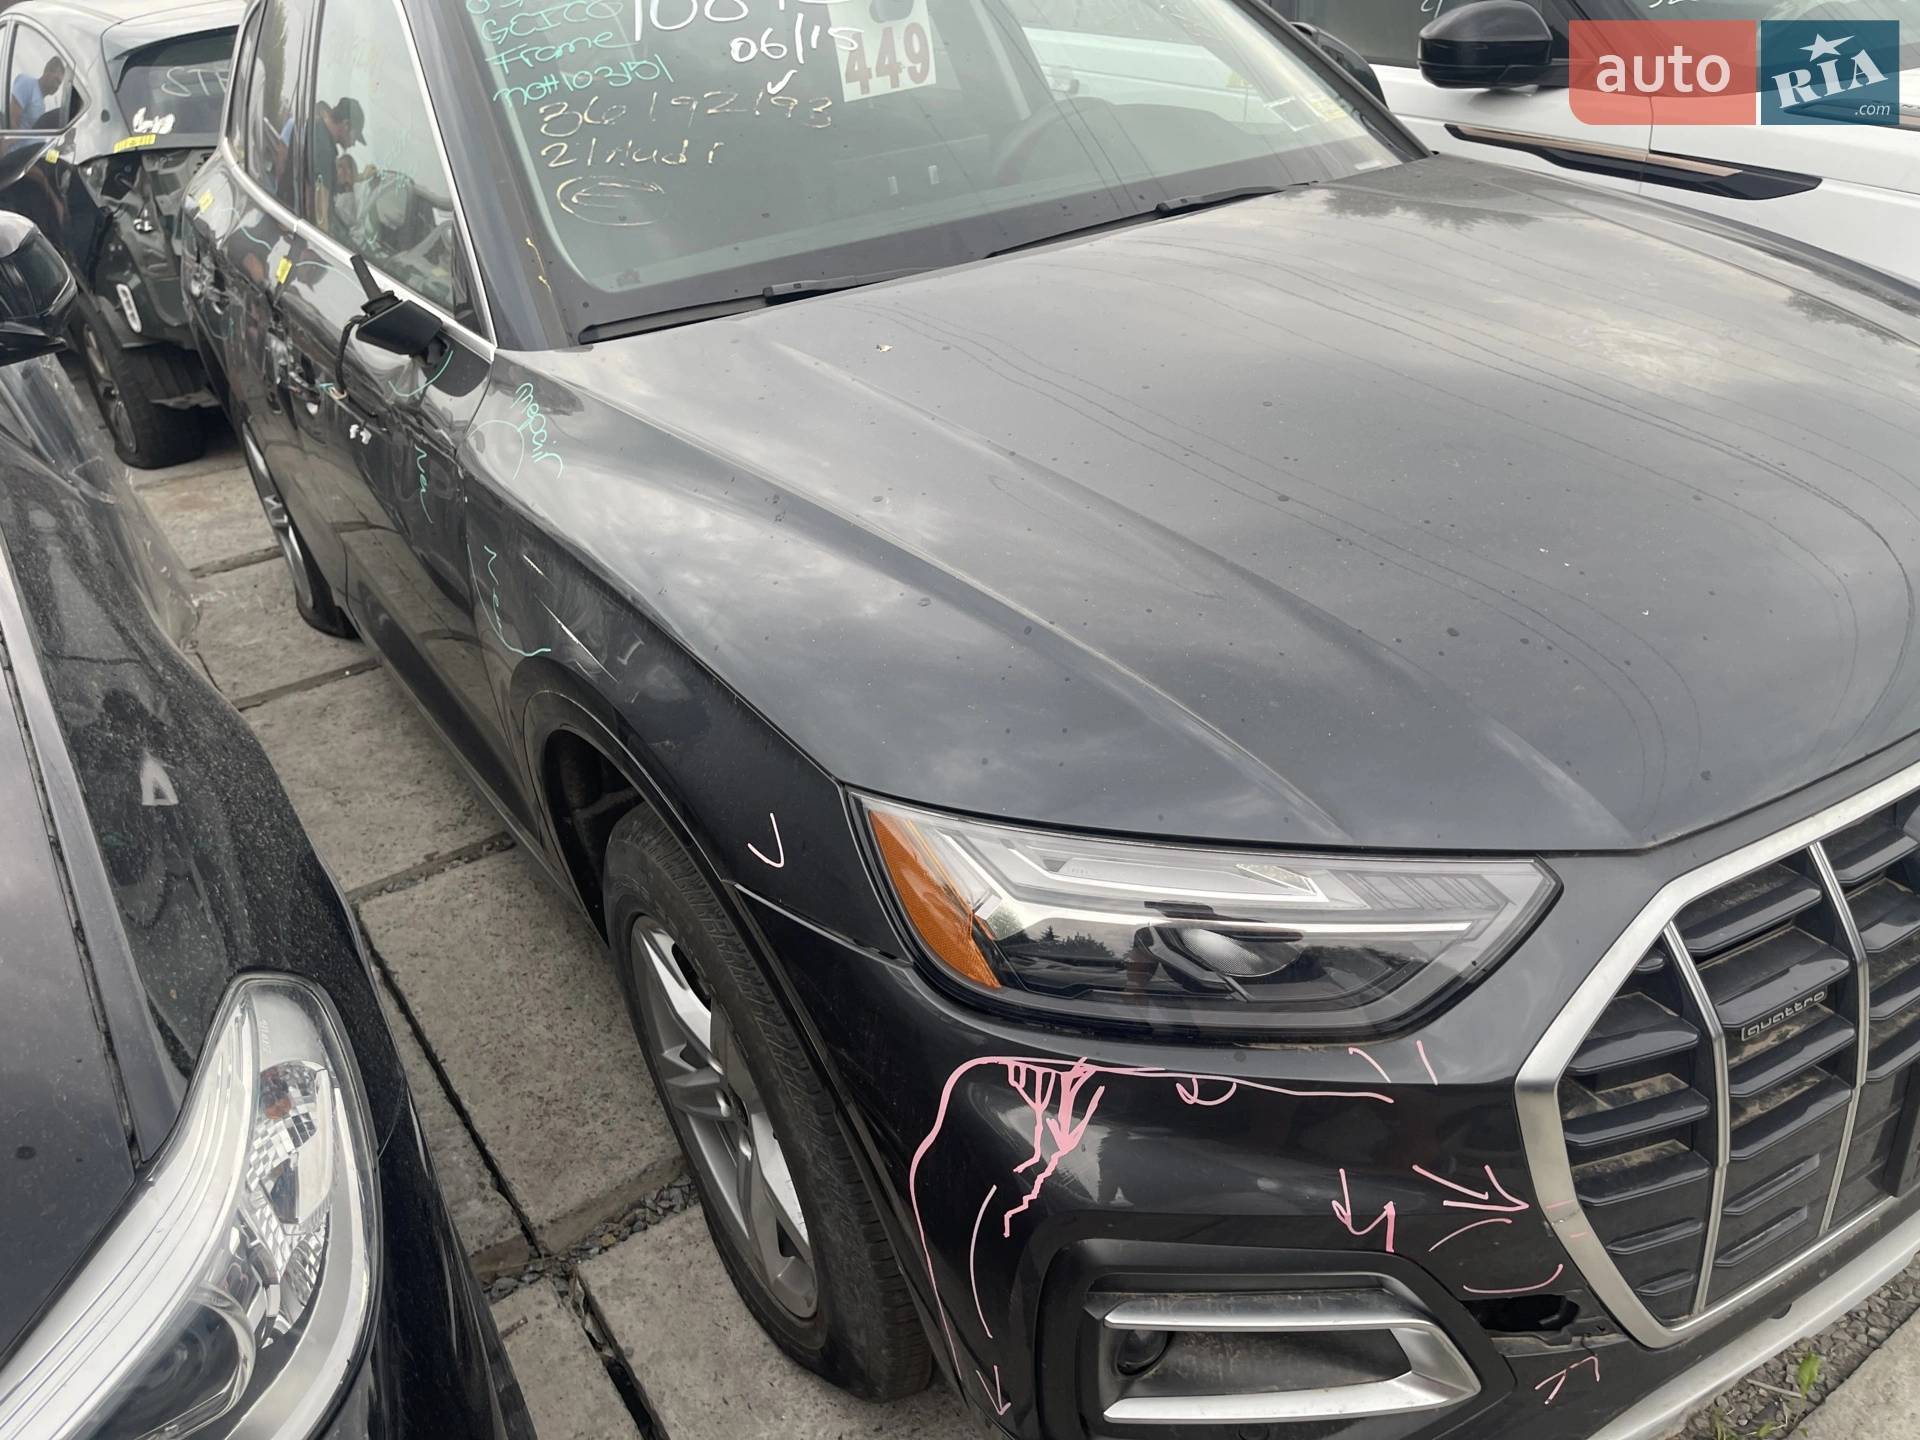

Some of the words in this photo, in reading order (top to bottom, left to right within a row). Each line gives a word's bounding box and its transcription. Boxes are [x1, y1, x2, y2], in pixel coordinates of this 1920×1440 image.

[481, 0, 624, 44] GEICO
[844, 22, 931, 95] 449
[1746, 990, 1825, 1036] quattro
